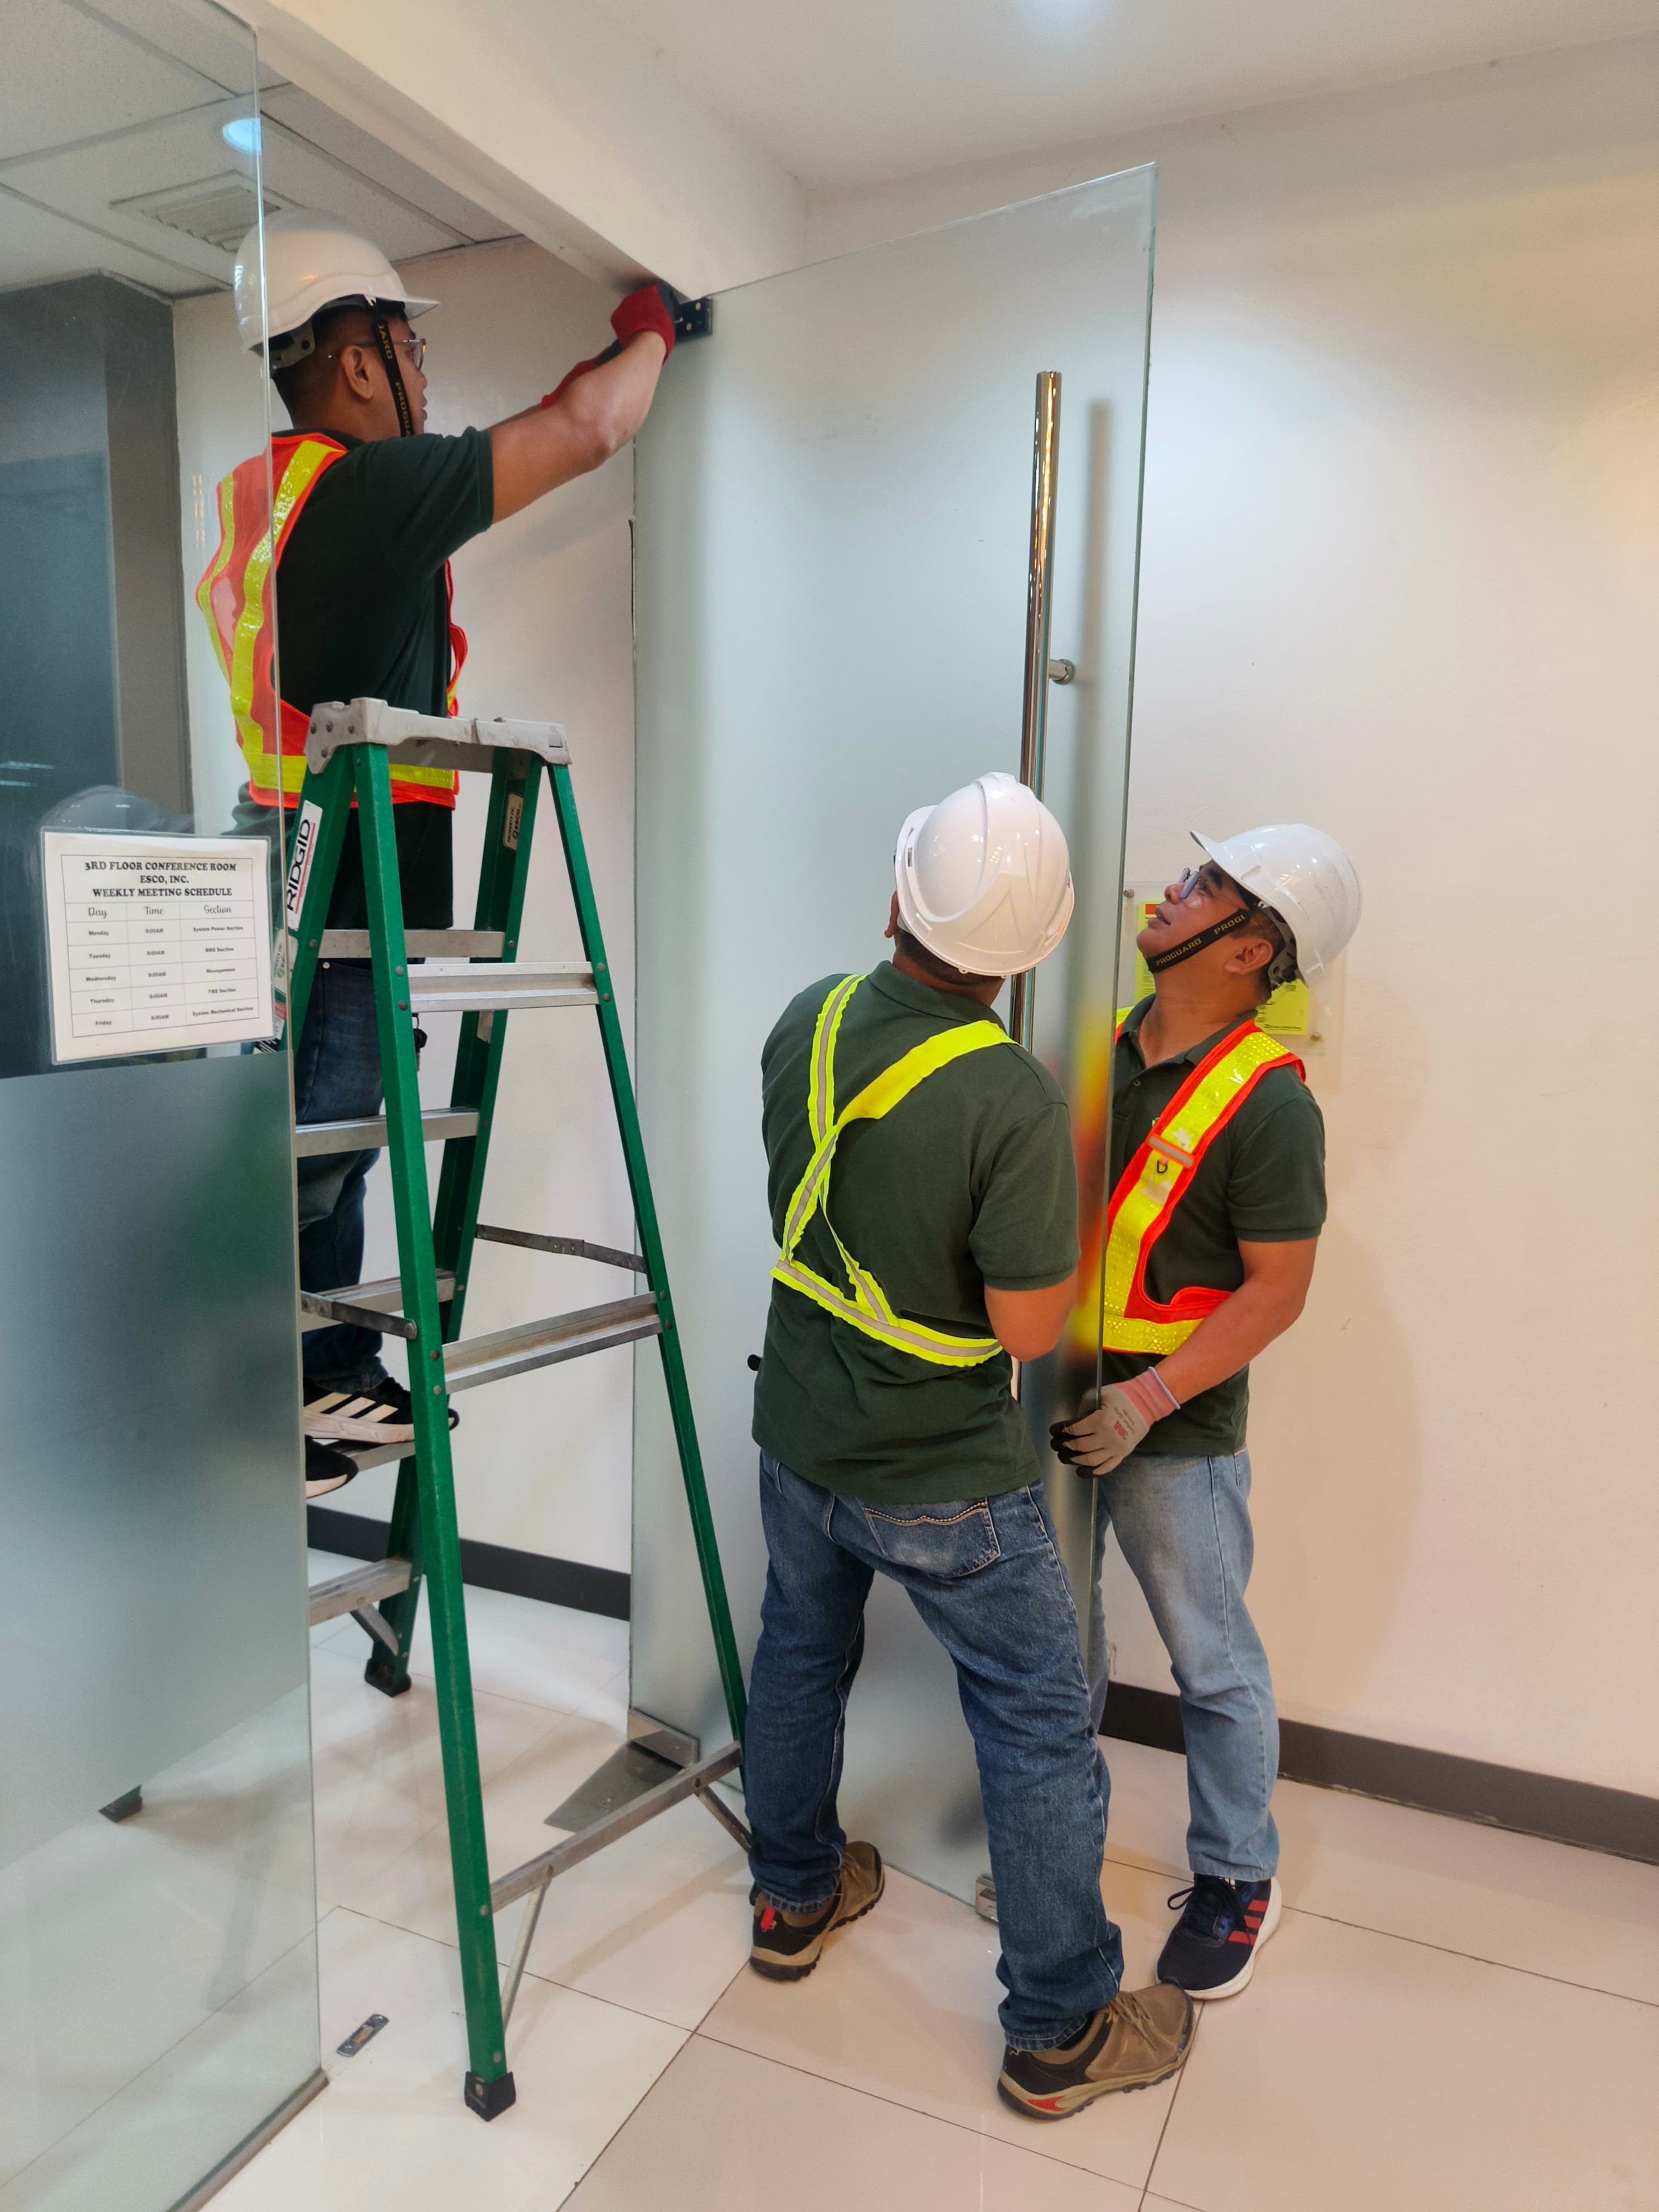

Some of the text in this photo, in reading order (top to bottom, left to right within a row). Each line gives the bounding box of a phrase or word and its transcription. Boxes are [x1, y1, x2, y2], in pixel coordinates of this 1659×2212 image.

[84, 861, 106, 871] 3RD
[109, 861, 143, 870] FLOOR
[145, 862, 208, 871] CONFERENCE
[287, 819, 311, 911] RIDGID
[140, 875, 167, 885] ESCO,
[93, 888, 232, 897] WEEKLY MEETING SCHEDULE
[88, 907, 107, 919] Day
[144, 906, 164, 915] Time
[204, 905, 232, 914] Section
[1156, 938, 1202, 967] PROGUARD
[1113, 1420, 1128, 1440] 3M
